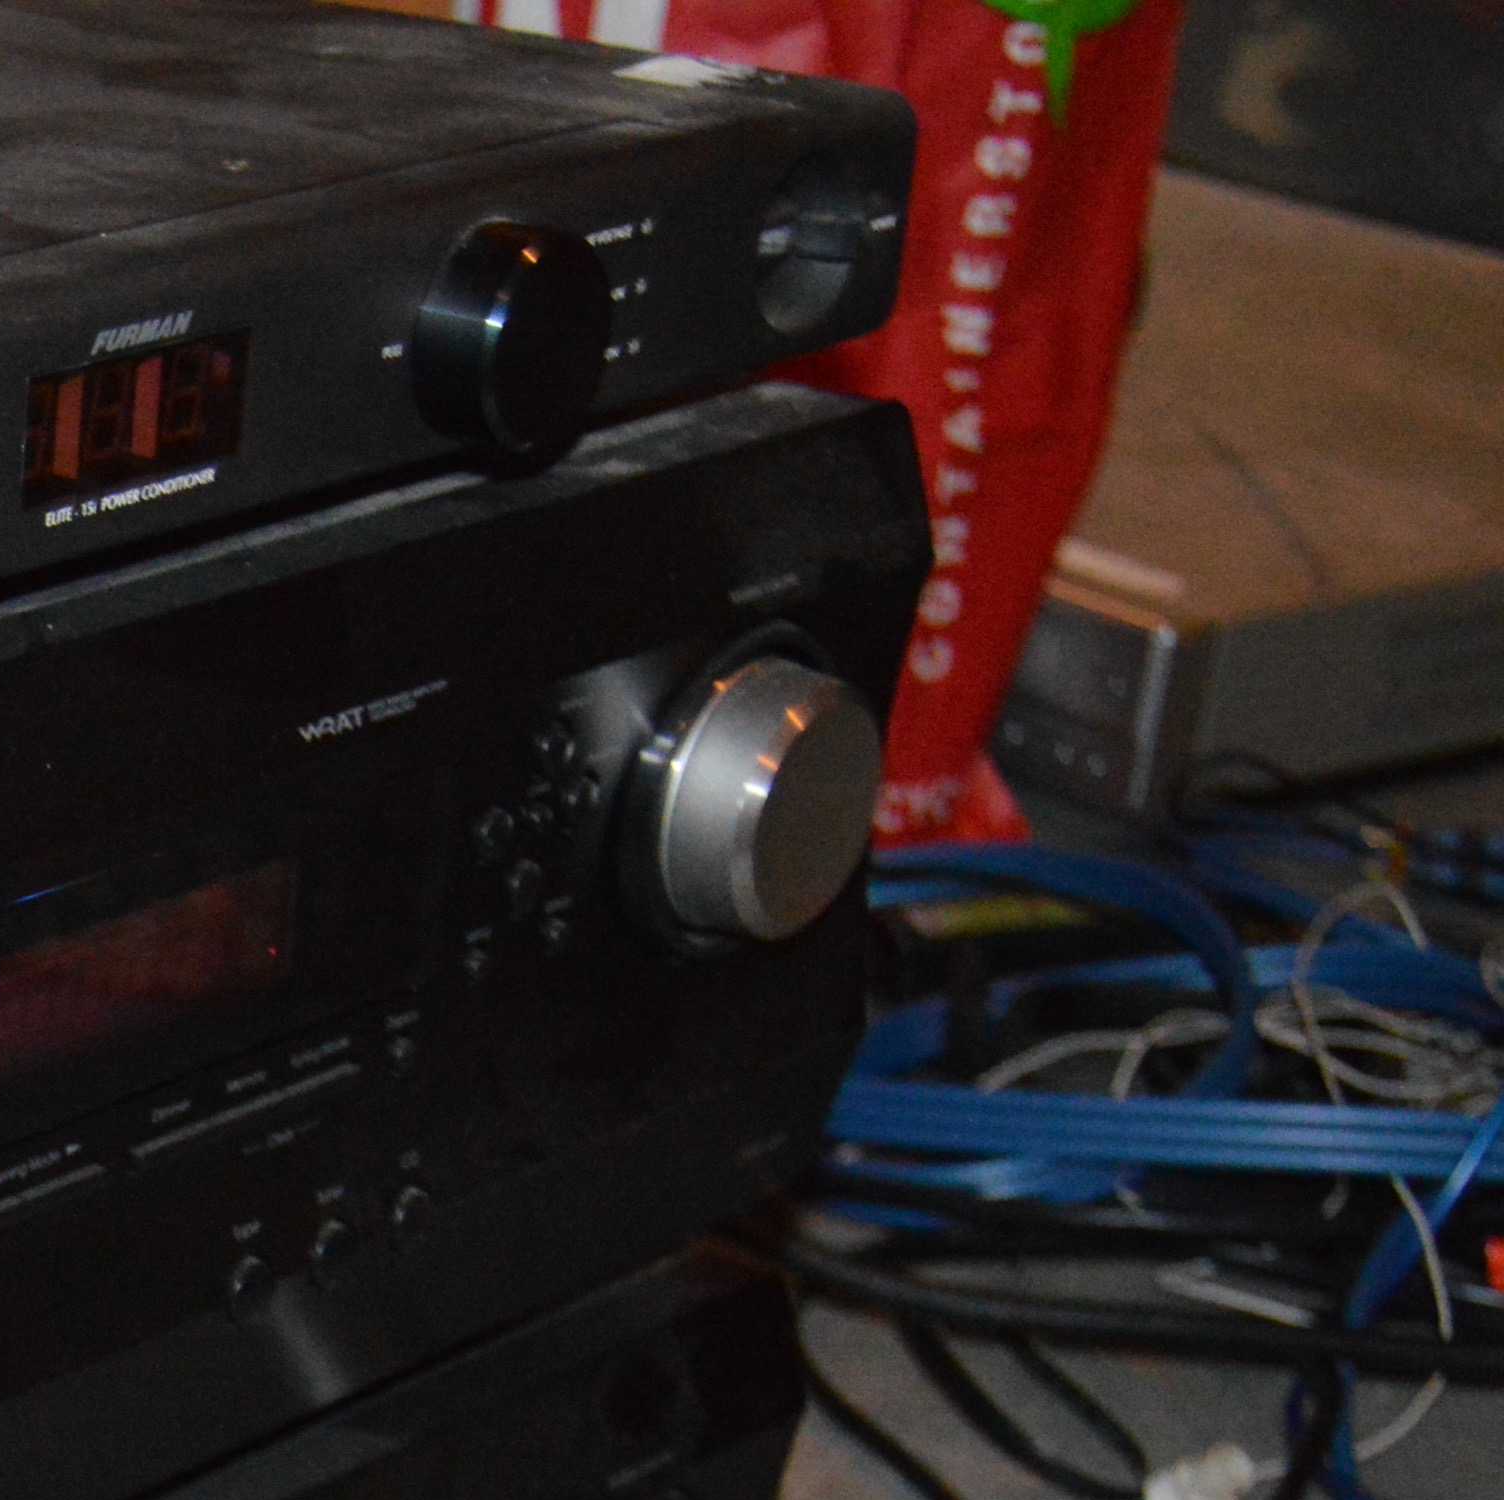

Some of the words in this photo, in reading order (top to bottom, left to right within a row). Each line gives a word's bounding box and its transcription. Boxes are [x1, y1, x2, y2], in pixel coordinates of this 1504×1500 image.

[91, 310, 194, 356] FURMAN
[44, 506, 73, 528] ELITE
[100, 488, 141, 513] POWER
[140, 464, 219, 501] CONDITIONER
